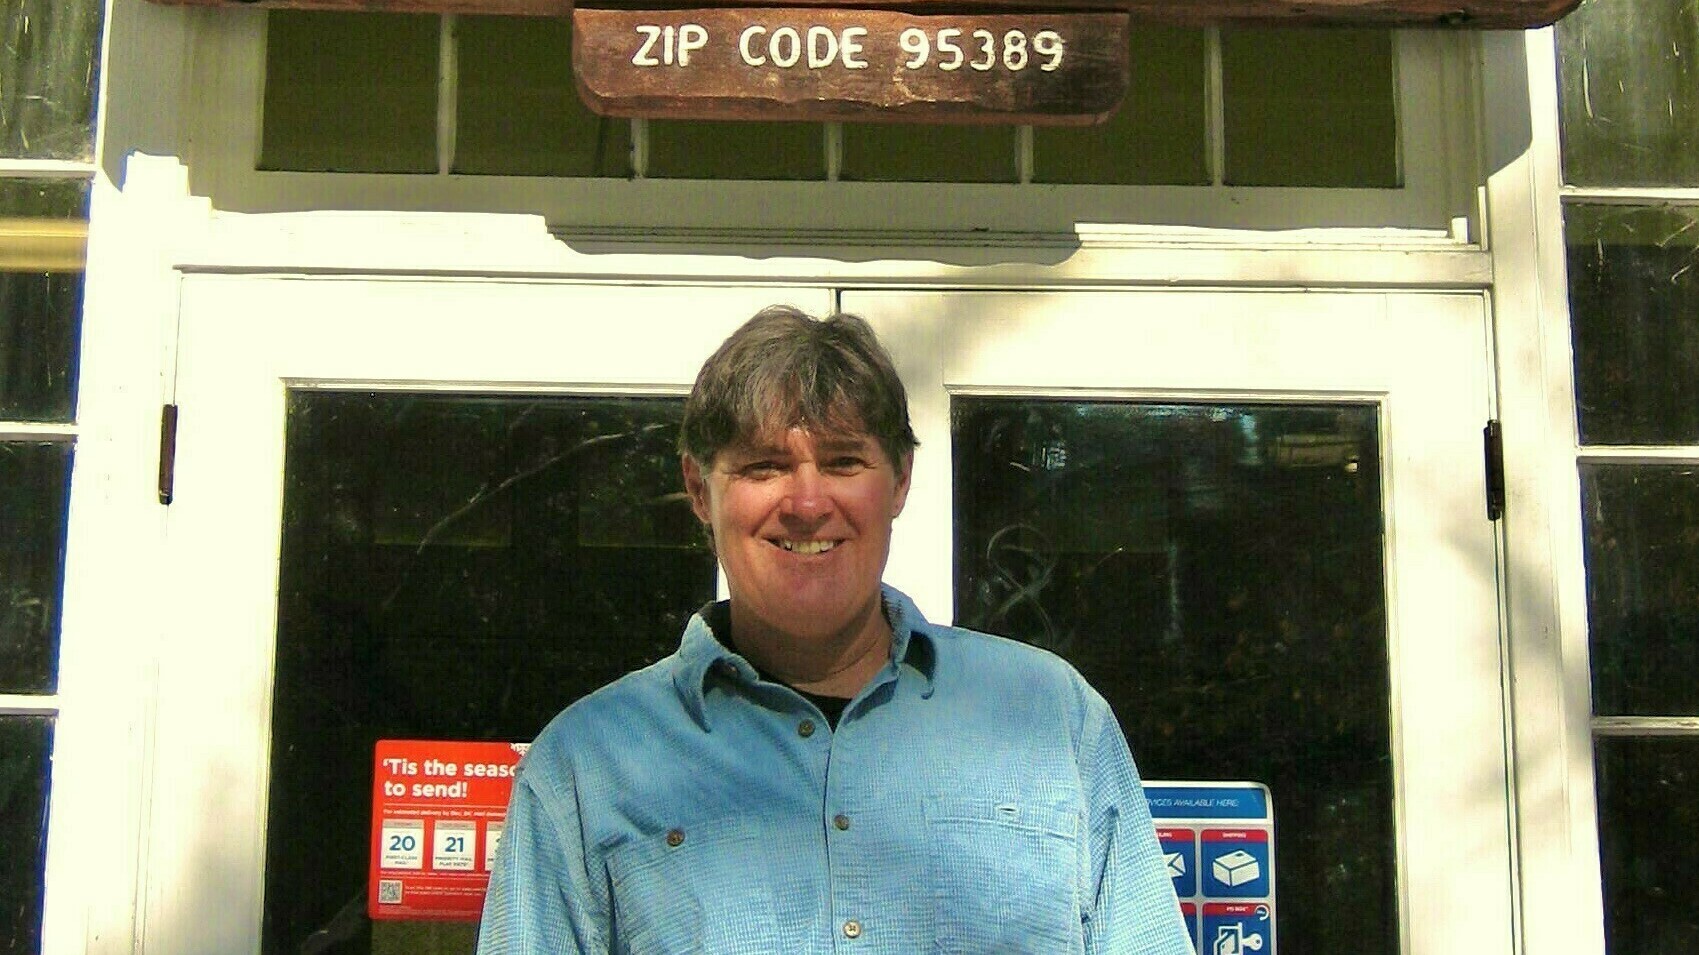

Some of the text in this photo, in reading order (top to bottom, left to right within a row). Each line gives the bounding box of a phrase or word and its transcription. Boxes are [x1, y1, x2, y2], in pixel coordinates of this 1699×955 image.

[631, 24, 1065, 72] ZIP CODE 95389
[424, 759, 458, 776] the
[384, 780, 468, 798] to send!
[389, 835, 416, 852] 20
[445, 836, 465, 853] 21
